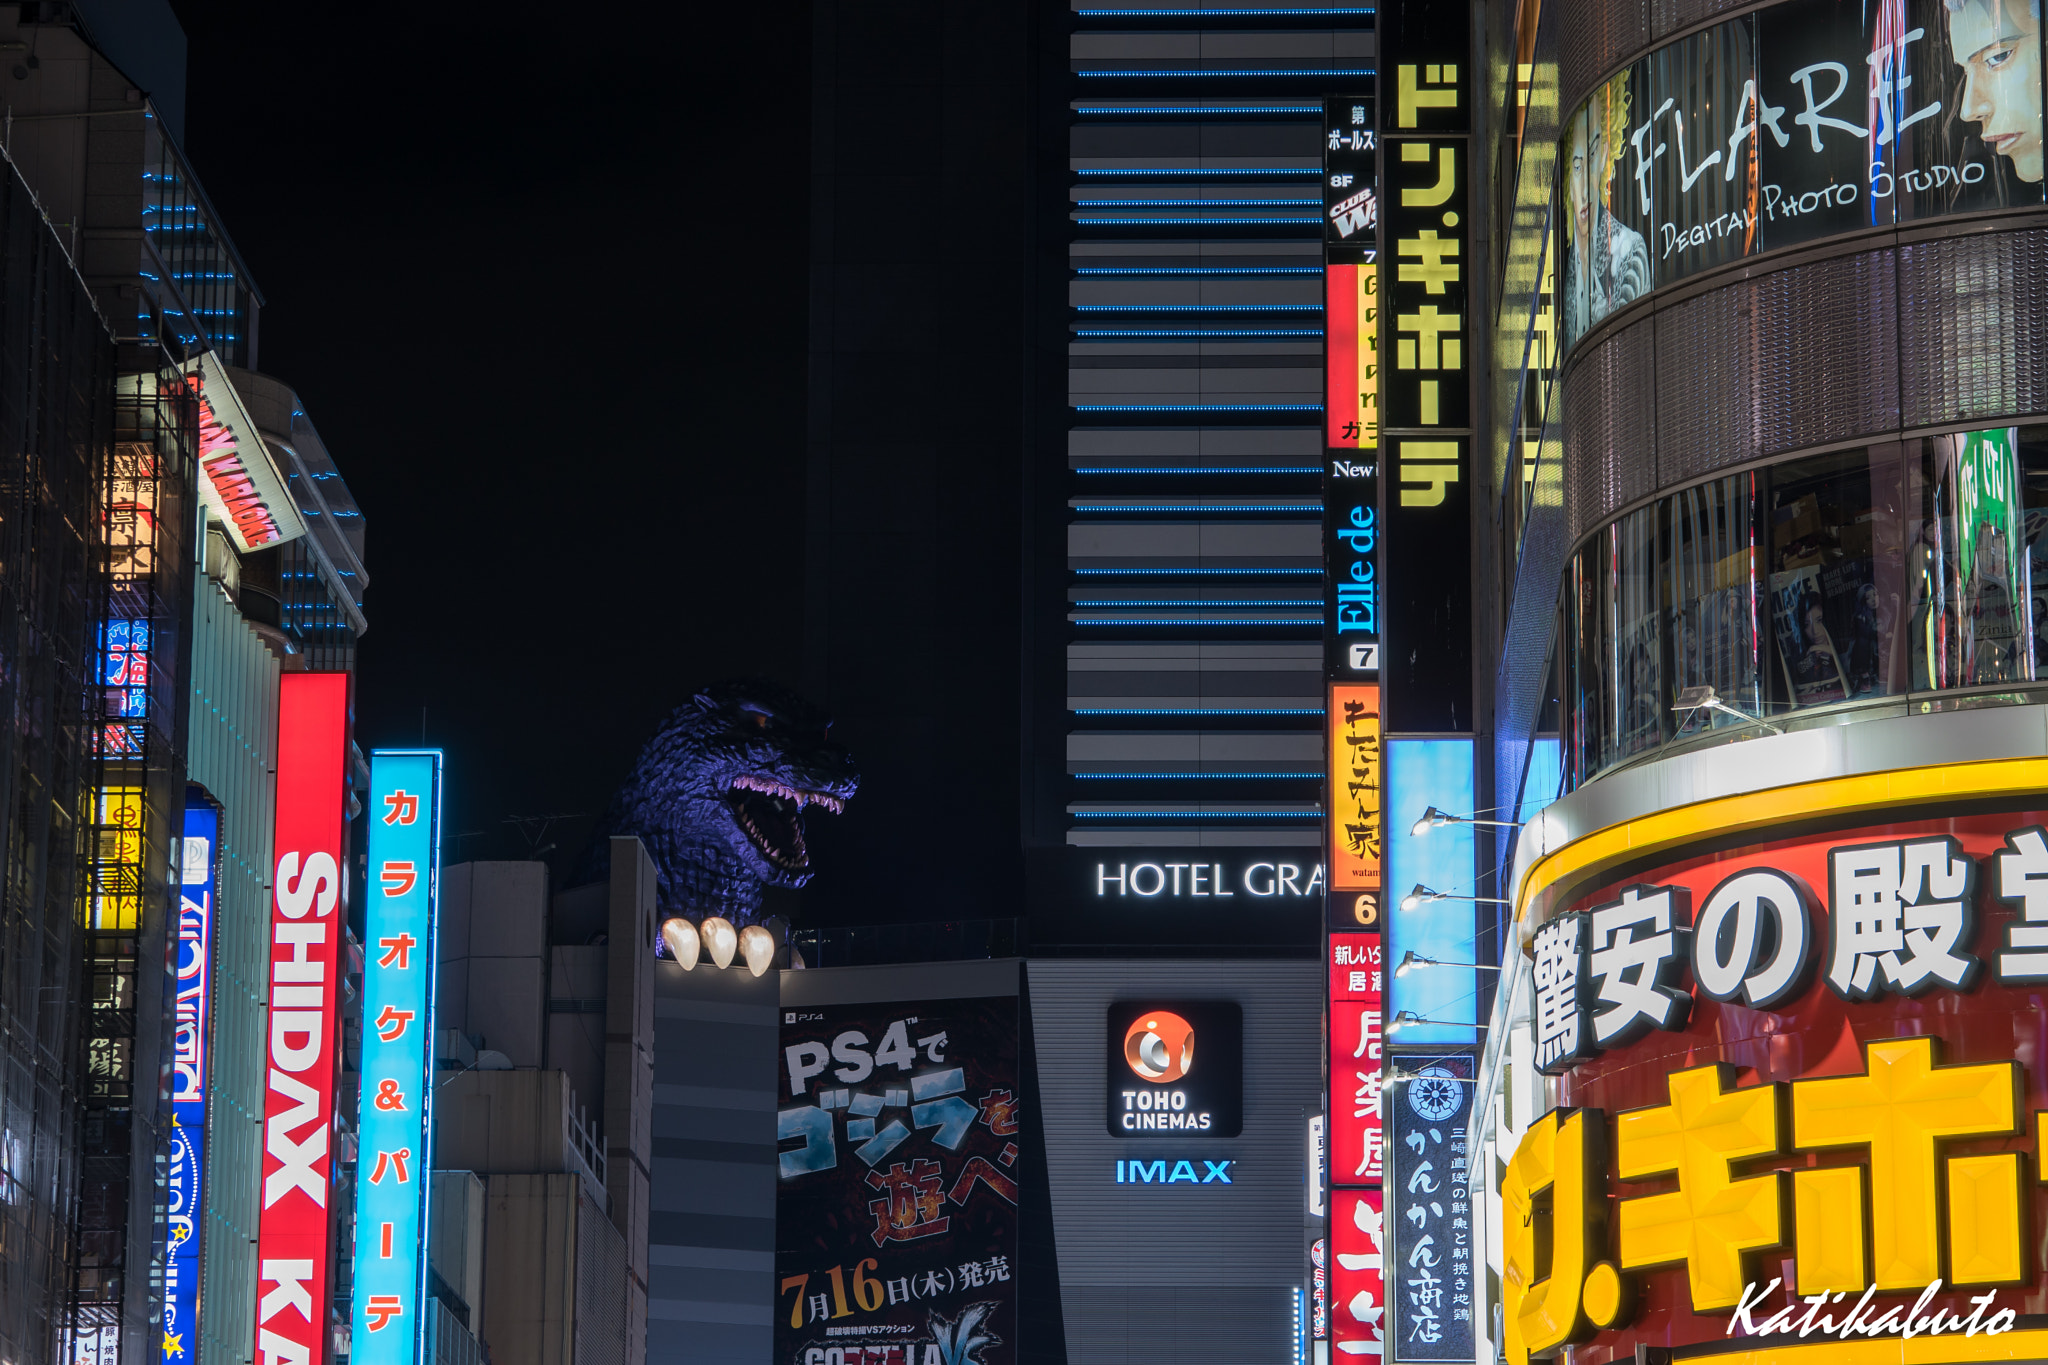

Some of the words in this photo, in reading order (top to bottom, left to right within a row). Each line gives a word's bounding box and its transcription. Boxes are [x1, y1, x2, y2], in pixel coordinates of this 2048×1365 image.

[1630, 27, 1942, 216] FLARE
[1329, 188, 1371, 218] CLUB
[1330, 174, 1354, 188] 8F
[1661, 208, 1758, 261] DEGITAL
[1762, 184, 1857, 221] PHOTO
[1868, 161, 1985, 198] STUDIO
[1332, 460, 1374, 478] New
[203, 453, 281, 549] KARAOKE
[1337, 560, 1374, 634] Elle
[1098, 863, 1234, 895] HOTEL
[264, 851, 338, 1210] SHIDAX
[364, 789, 420, 1333] カラオケ&パーテ
[1122, 1090, 1186, 1111] TOHO
[1122, 1113, 1212, 1130] CINEMAS
[1116, 1159, 1233, 1185] IMAX
[1405, 1128, 1443, 1344] かんかん商店
